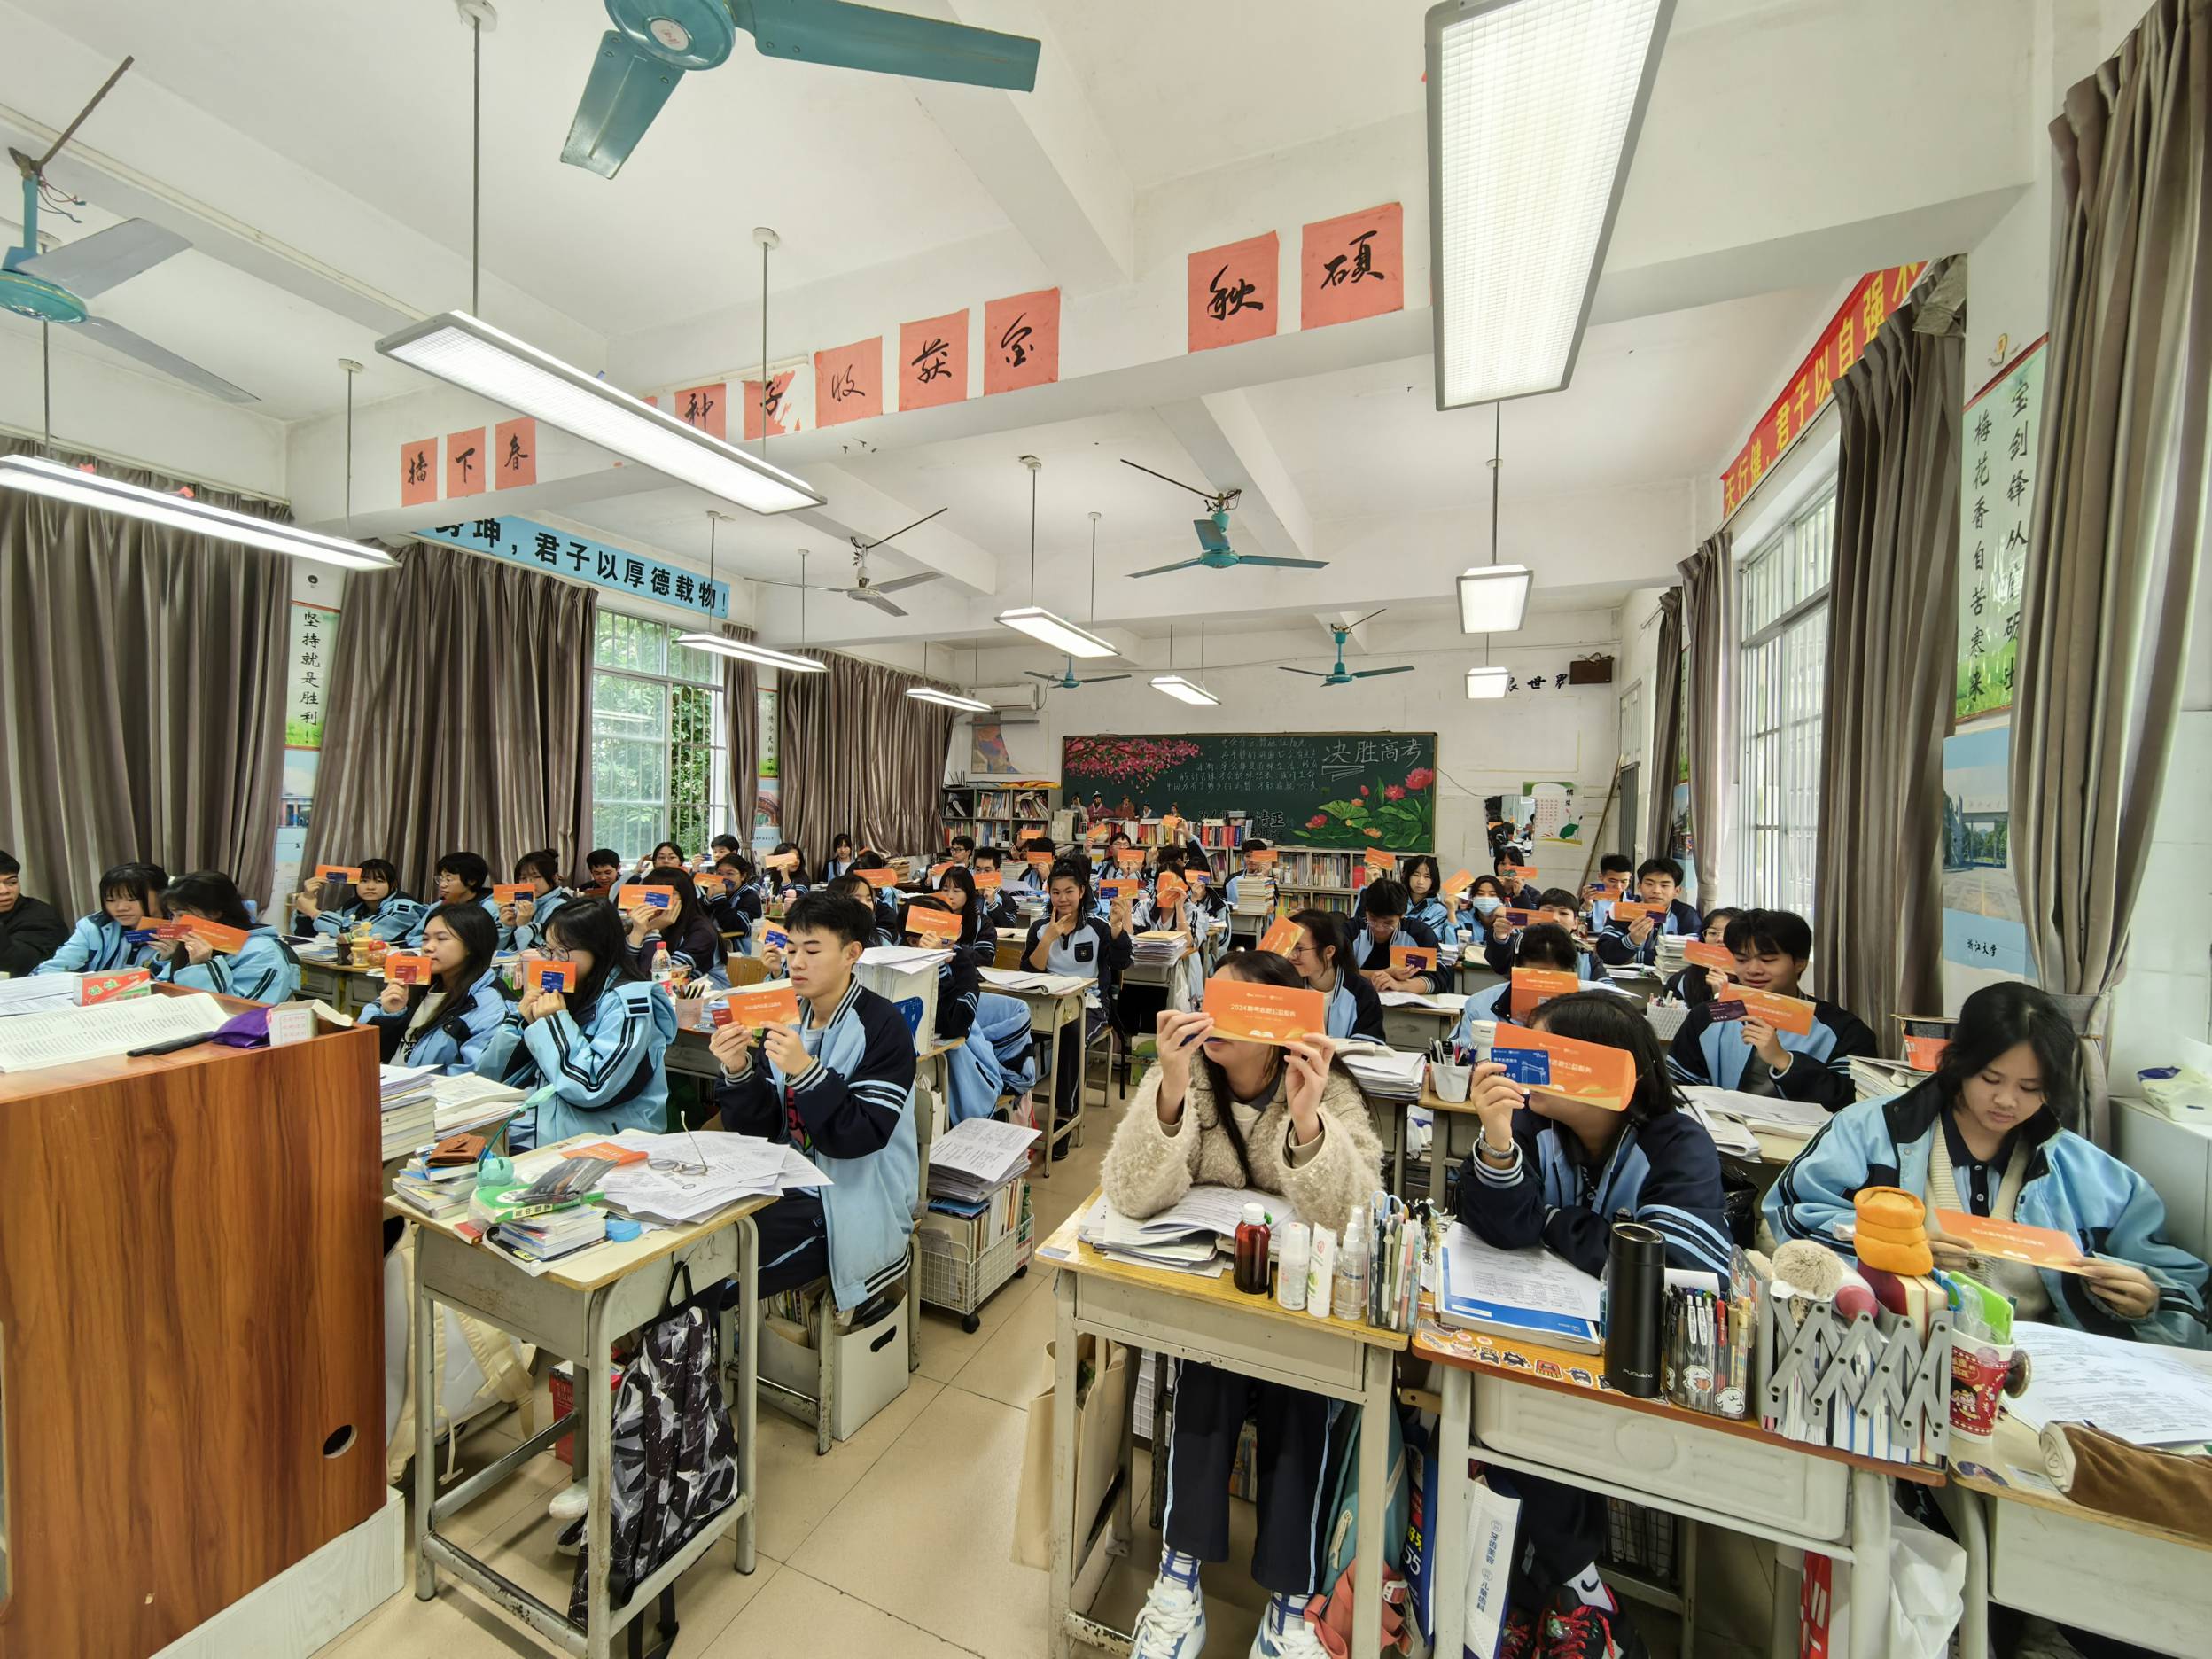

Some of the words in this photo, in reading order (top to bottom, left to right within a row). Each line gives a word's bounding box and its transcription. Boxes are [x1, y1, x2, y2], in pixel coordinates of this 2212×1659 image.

[1968, 409, 1993, 702] 梅花香自苦寒来
[300, 611, 321, 744] 坚持就是胜利！
[1321, 737, 1422, 769] 决胜高考
